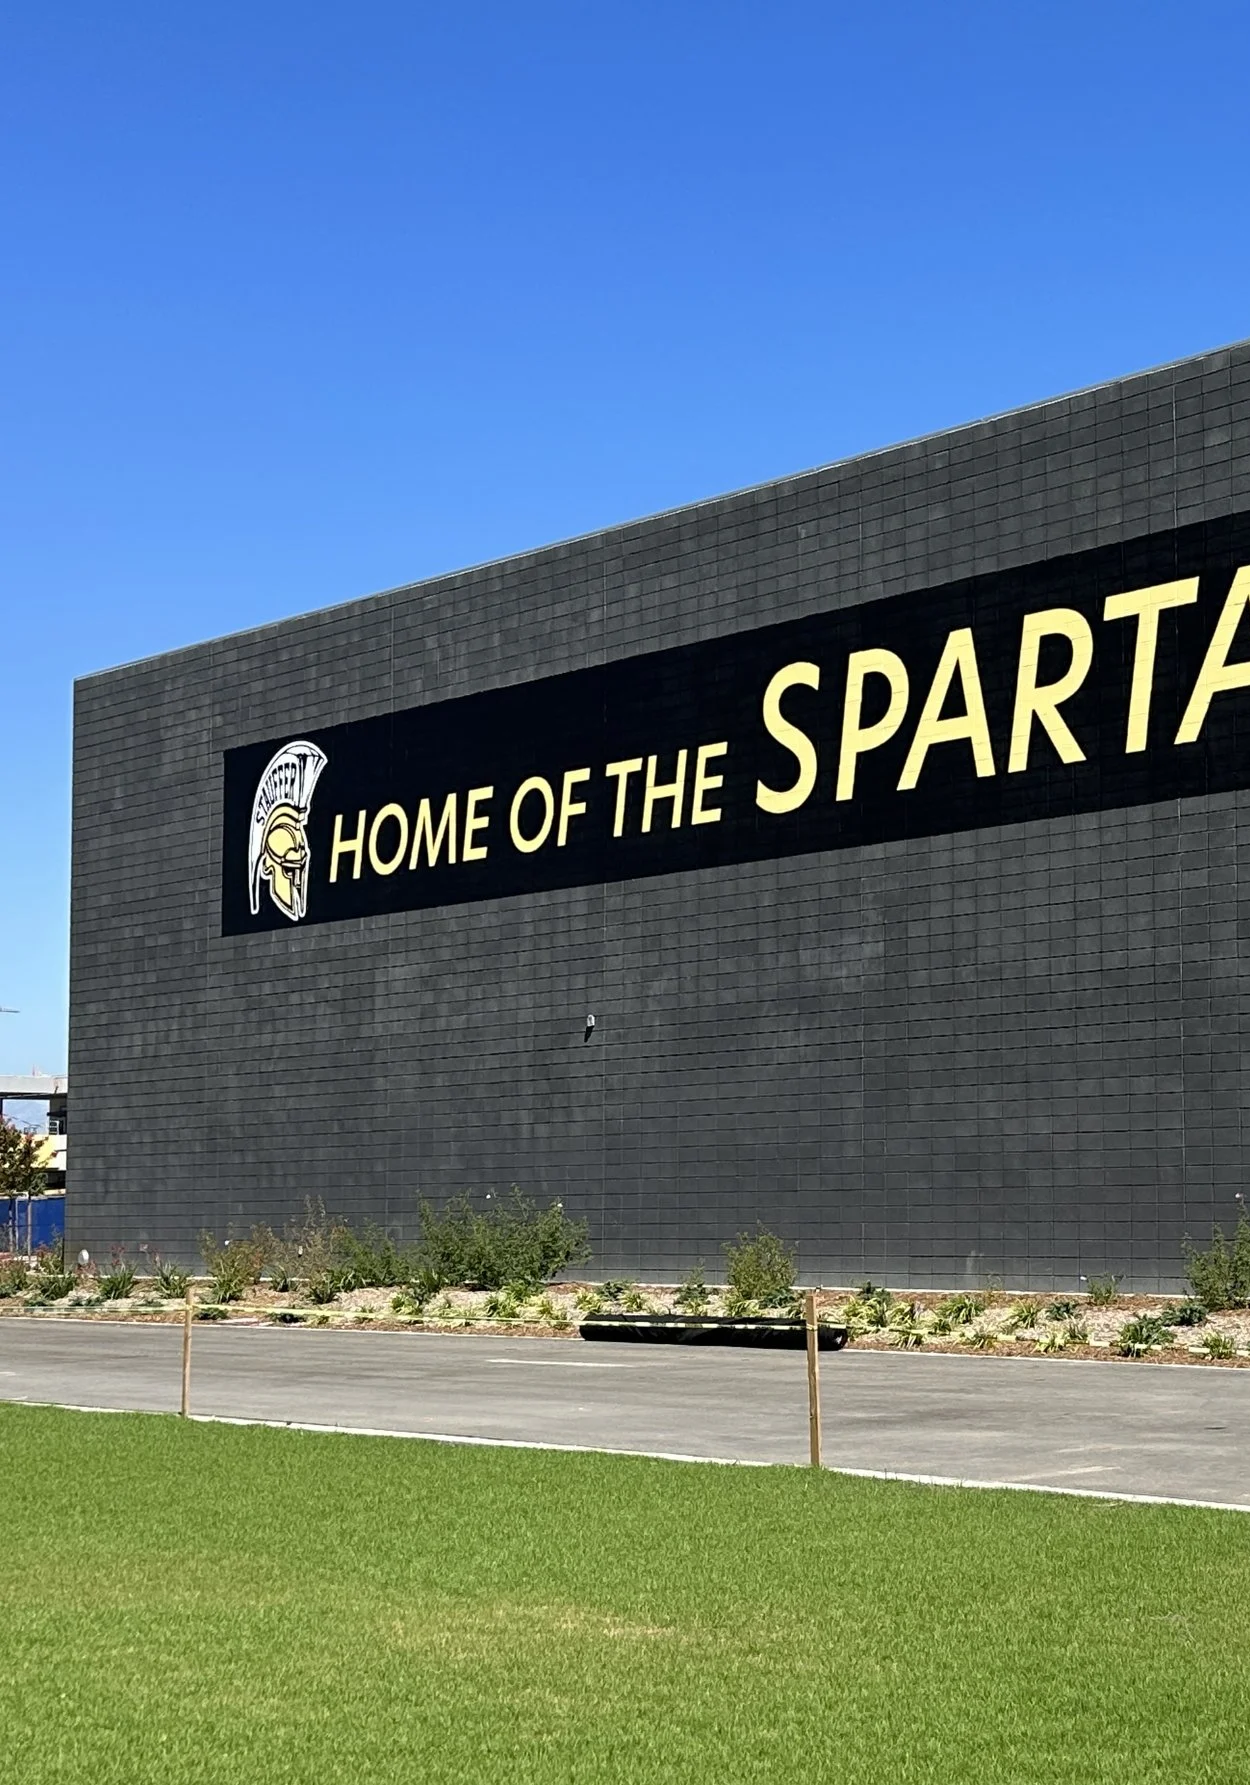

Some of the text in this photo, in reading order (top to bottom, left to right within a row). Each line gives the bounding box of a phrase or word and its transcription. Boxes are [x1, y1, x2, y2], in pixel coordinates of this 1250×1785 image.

[255, 762, 297, 826] STAUFFER
[329, 785, 494, 884] HOME
[509, 767, 591, 853] OF
[605, 741, 728, 838] THE
